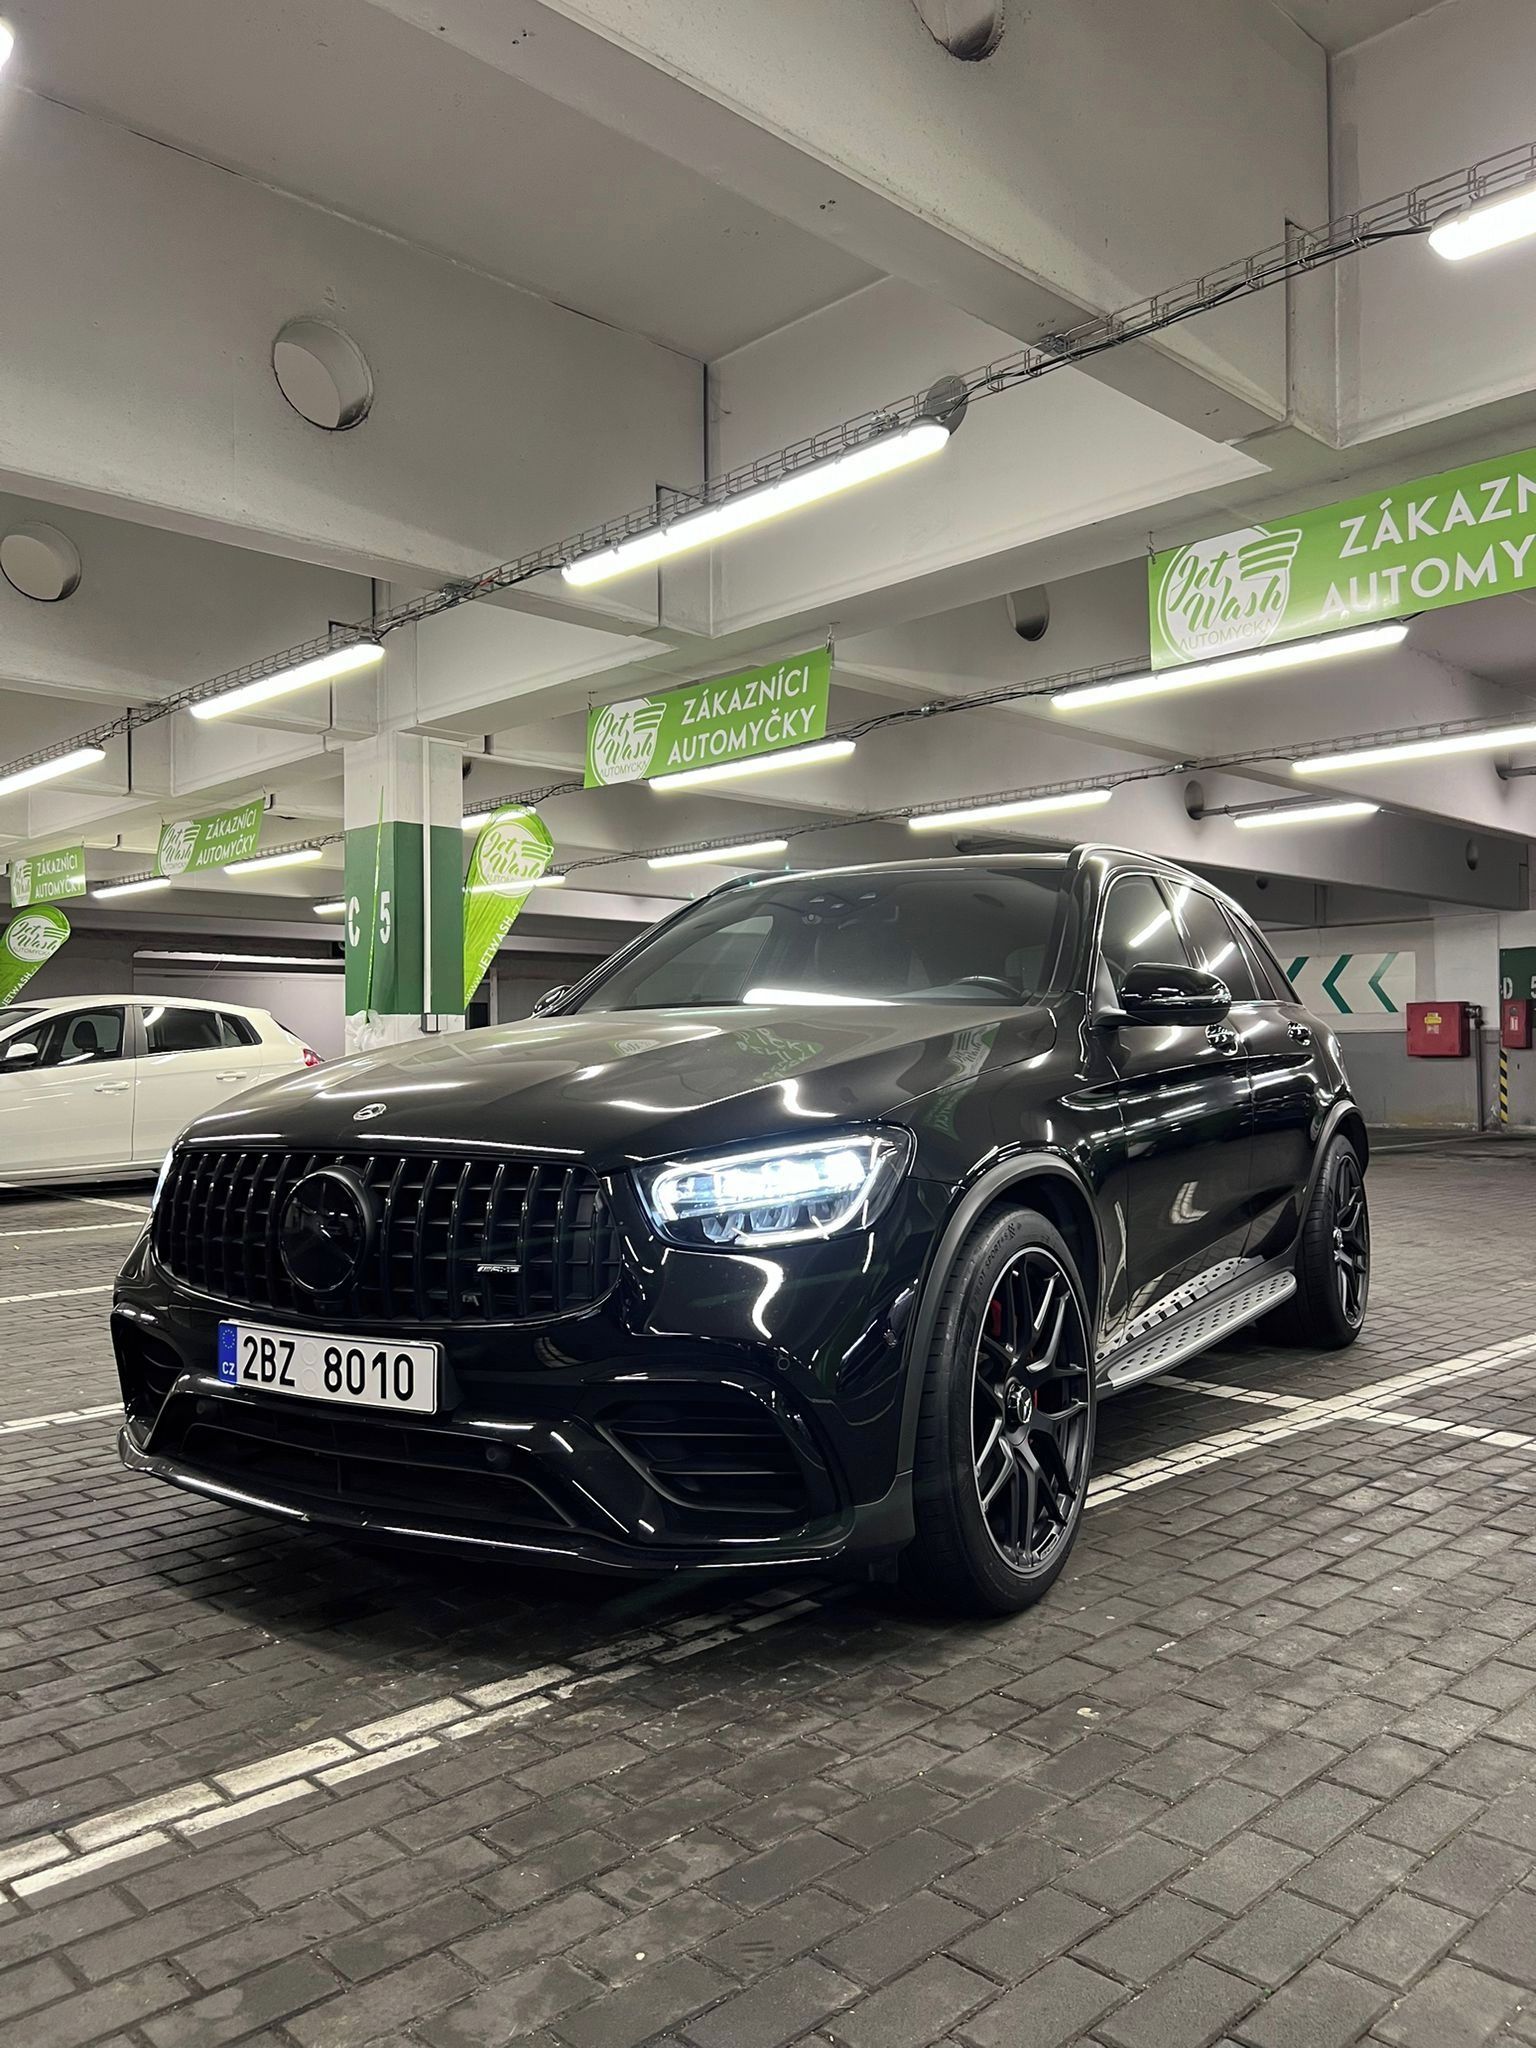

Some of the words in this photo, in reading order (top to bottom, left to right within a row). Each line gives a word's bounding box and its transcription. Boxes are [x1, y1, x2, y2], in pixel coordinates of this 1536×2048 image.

[1168, 550, 1236, 612] Jet
[1321, 533, 1536, 618] AUTOMY
[1182, 574, 1283, 633] Wash
[680, 665, 809, 726] ZÁKAZNÍCI
[603, 729, 653, 766] Wash
[666, 704, 817, 766] AUTOMYČKY
[205, 808, 257, 841] ZÁKAZNÍCI
[37, 852, 78, 877] ZÁKAZNÍCI
[195, 833, 256, 867] AUTOMYČKY
[489, 851, 541, 877] Wash
[348, 896, 360, 947] C
[379, 890, 391, 944] 5
[1502, 976, 1513, 1000] D
[222, 1361, 236, 1376] CZ
[242, 1335, 296, 1387] 2BZ
[323, 1346, 414, 1401] 8010
